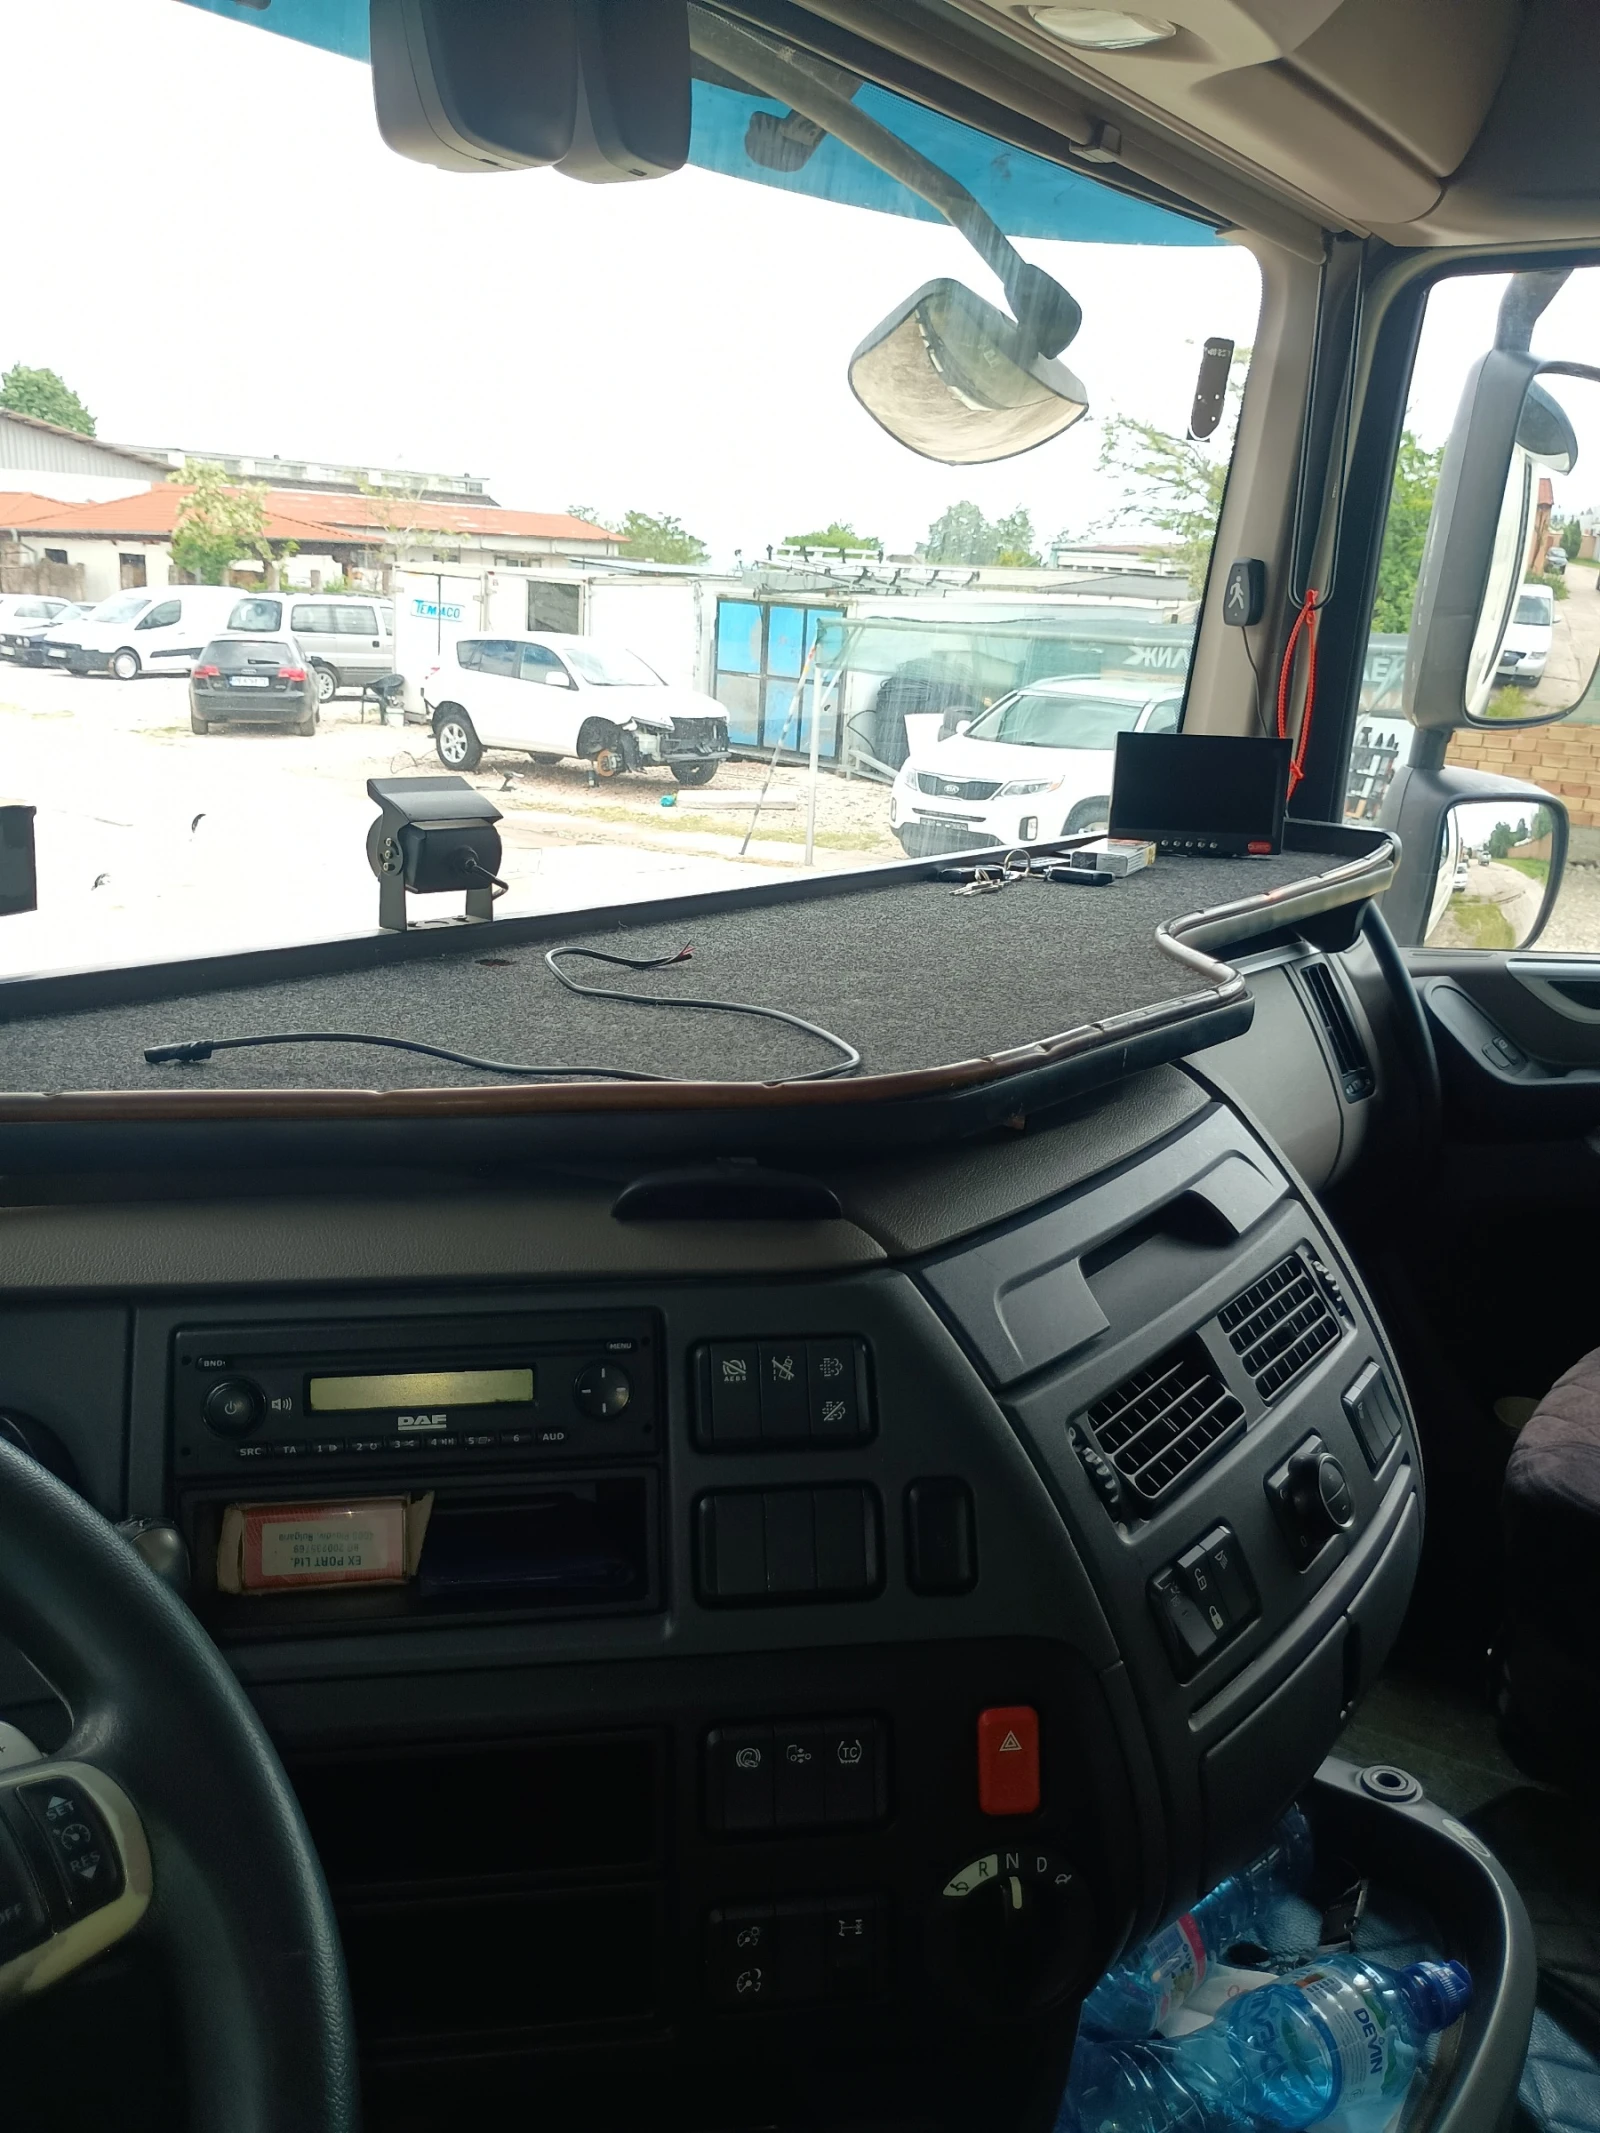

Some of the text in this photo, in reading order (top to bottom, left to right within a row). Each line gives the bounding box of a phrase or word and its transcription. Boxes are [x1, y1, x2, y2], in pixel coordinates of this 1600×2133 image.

[413, 599, 461, 619] TEMACO
[609, 1342, 632, 1350] MENU
[397, 1414, 447, 1427] DAF
[239, 1432, 565, 1457] SRC TA 1 2 3 4 5 6 AUD
[290, 1555, 362, 1568] EX PORT Ltd.
[842, 1746, 858, 1759] TC
[45, 1799, 75, 1821] SET
[70, 1850, 101, 1872] RES
[978, 1852, 1048, 1877] R N D
[1353, 2007, 1384, 2074] DEVIN
